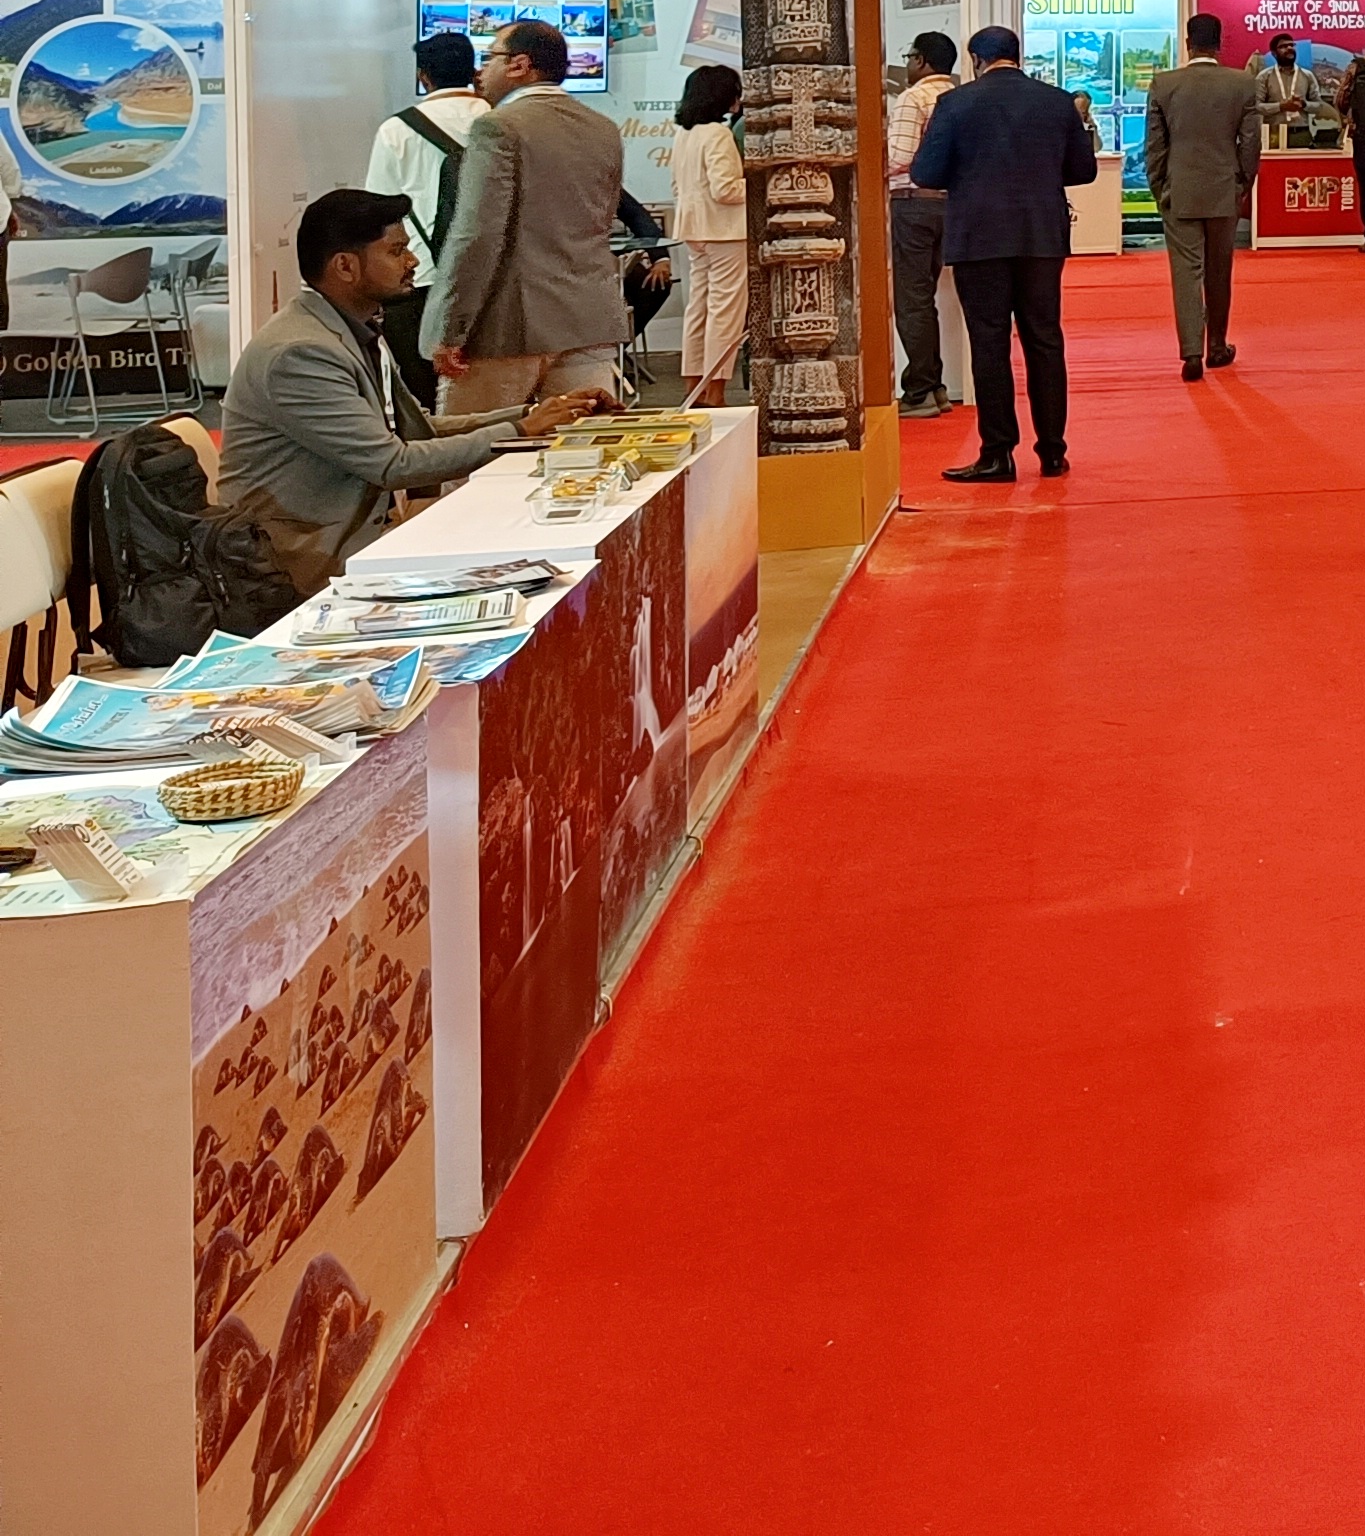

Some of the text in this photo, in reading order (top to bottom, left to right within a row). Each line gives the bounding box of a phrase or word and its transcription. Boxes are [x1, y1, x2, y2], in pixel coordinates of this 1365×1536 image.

[1258, 0, 1360, 14] HEART OF INDIA
[1244, 14, 1304, 34] MADHYA
[207, 82, 223, 91] Dal
[89, 165, 123, 175] Ladakh
[1284, 176, 1354, 211] MP TOURS
